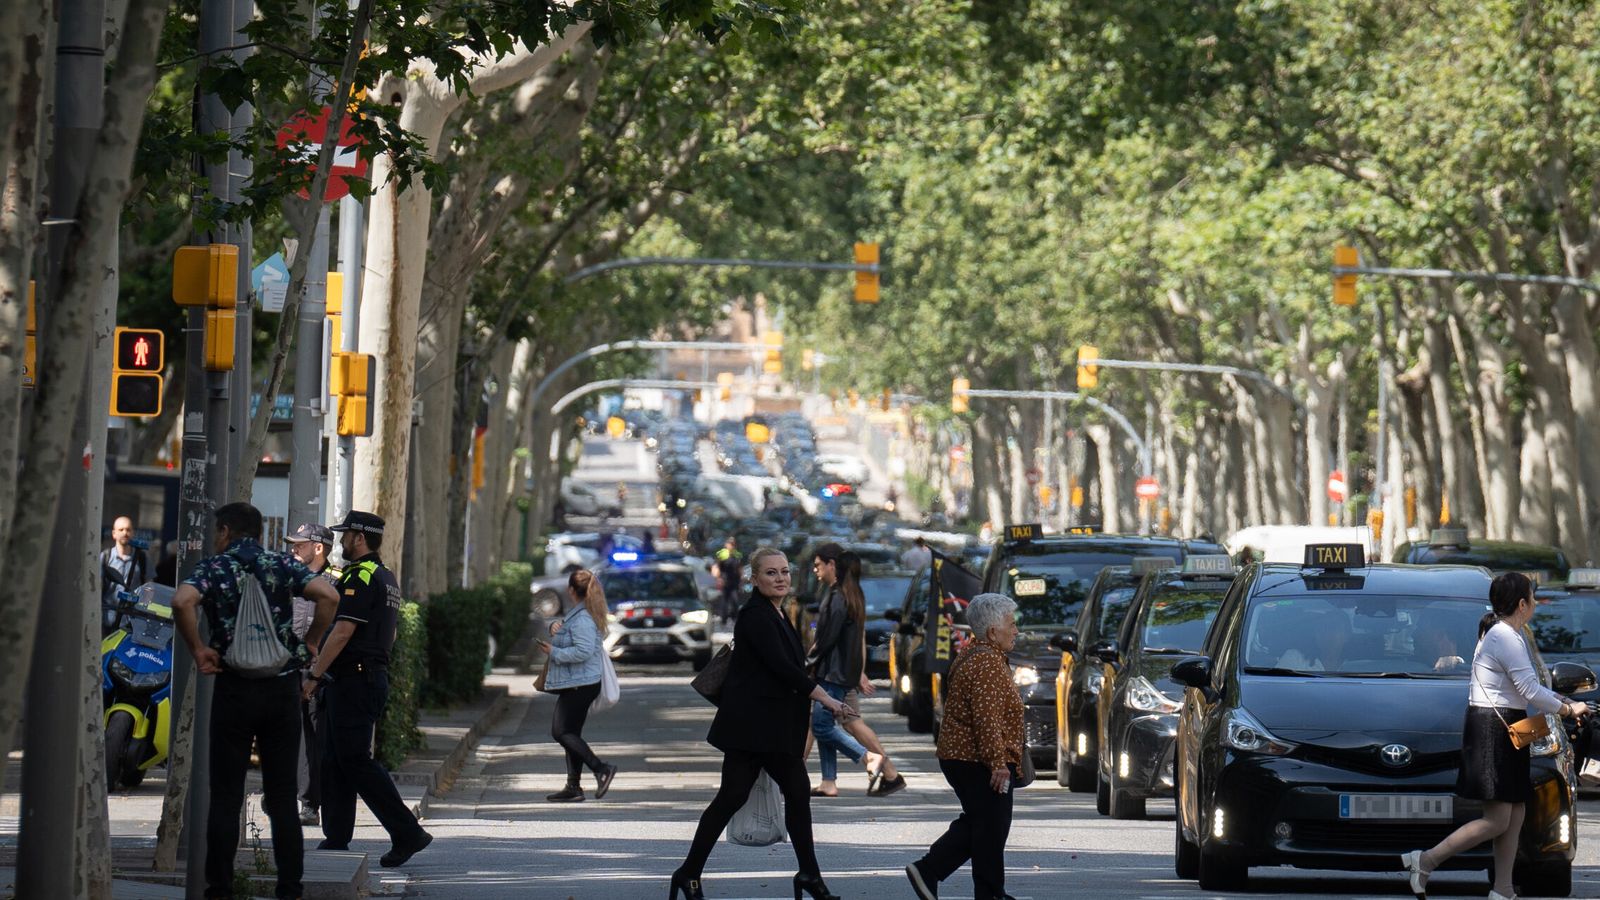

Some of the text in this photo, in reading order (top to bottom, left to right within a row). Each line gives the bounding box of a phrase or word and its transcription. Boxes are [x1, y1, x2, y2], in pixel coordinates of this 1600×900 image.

[1011, 526, 1032, 538] TAXI
[1316, 547, 1347, 563] TAXI
[1195, 559, 1216, 570] TAXI
